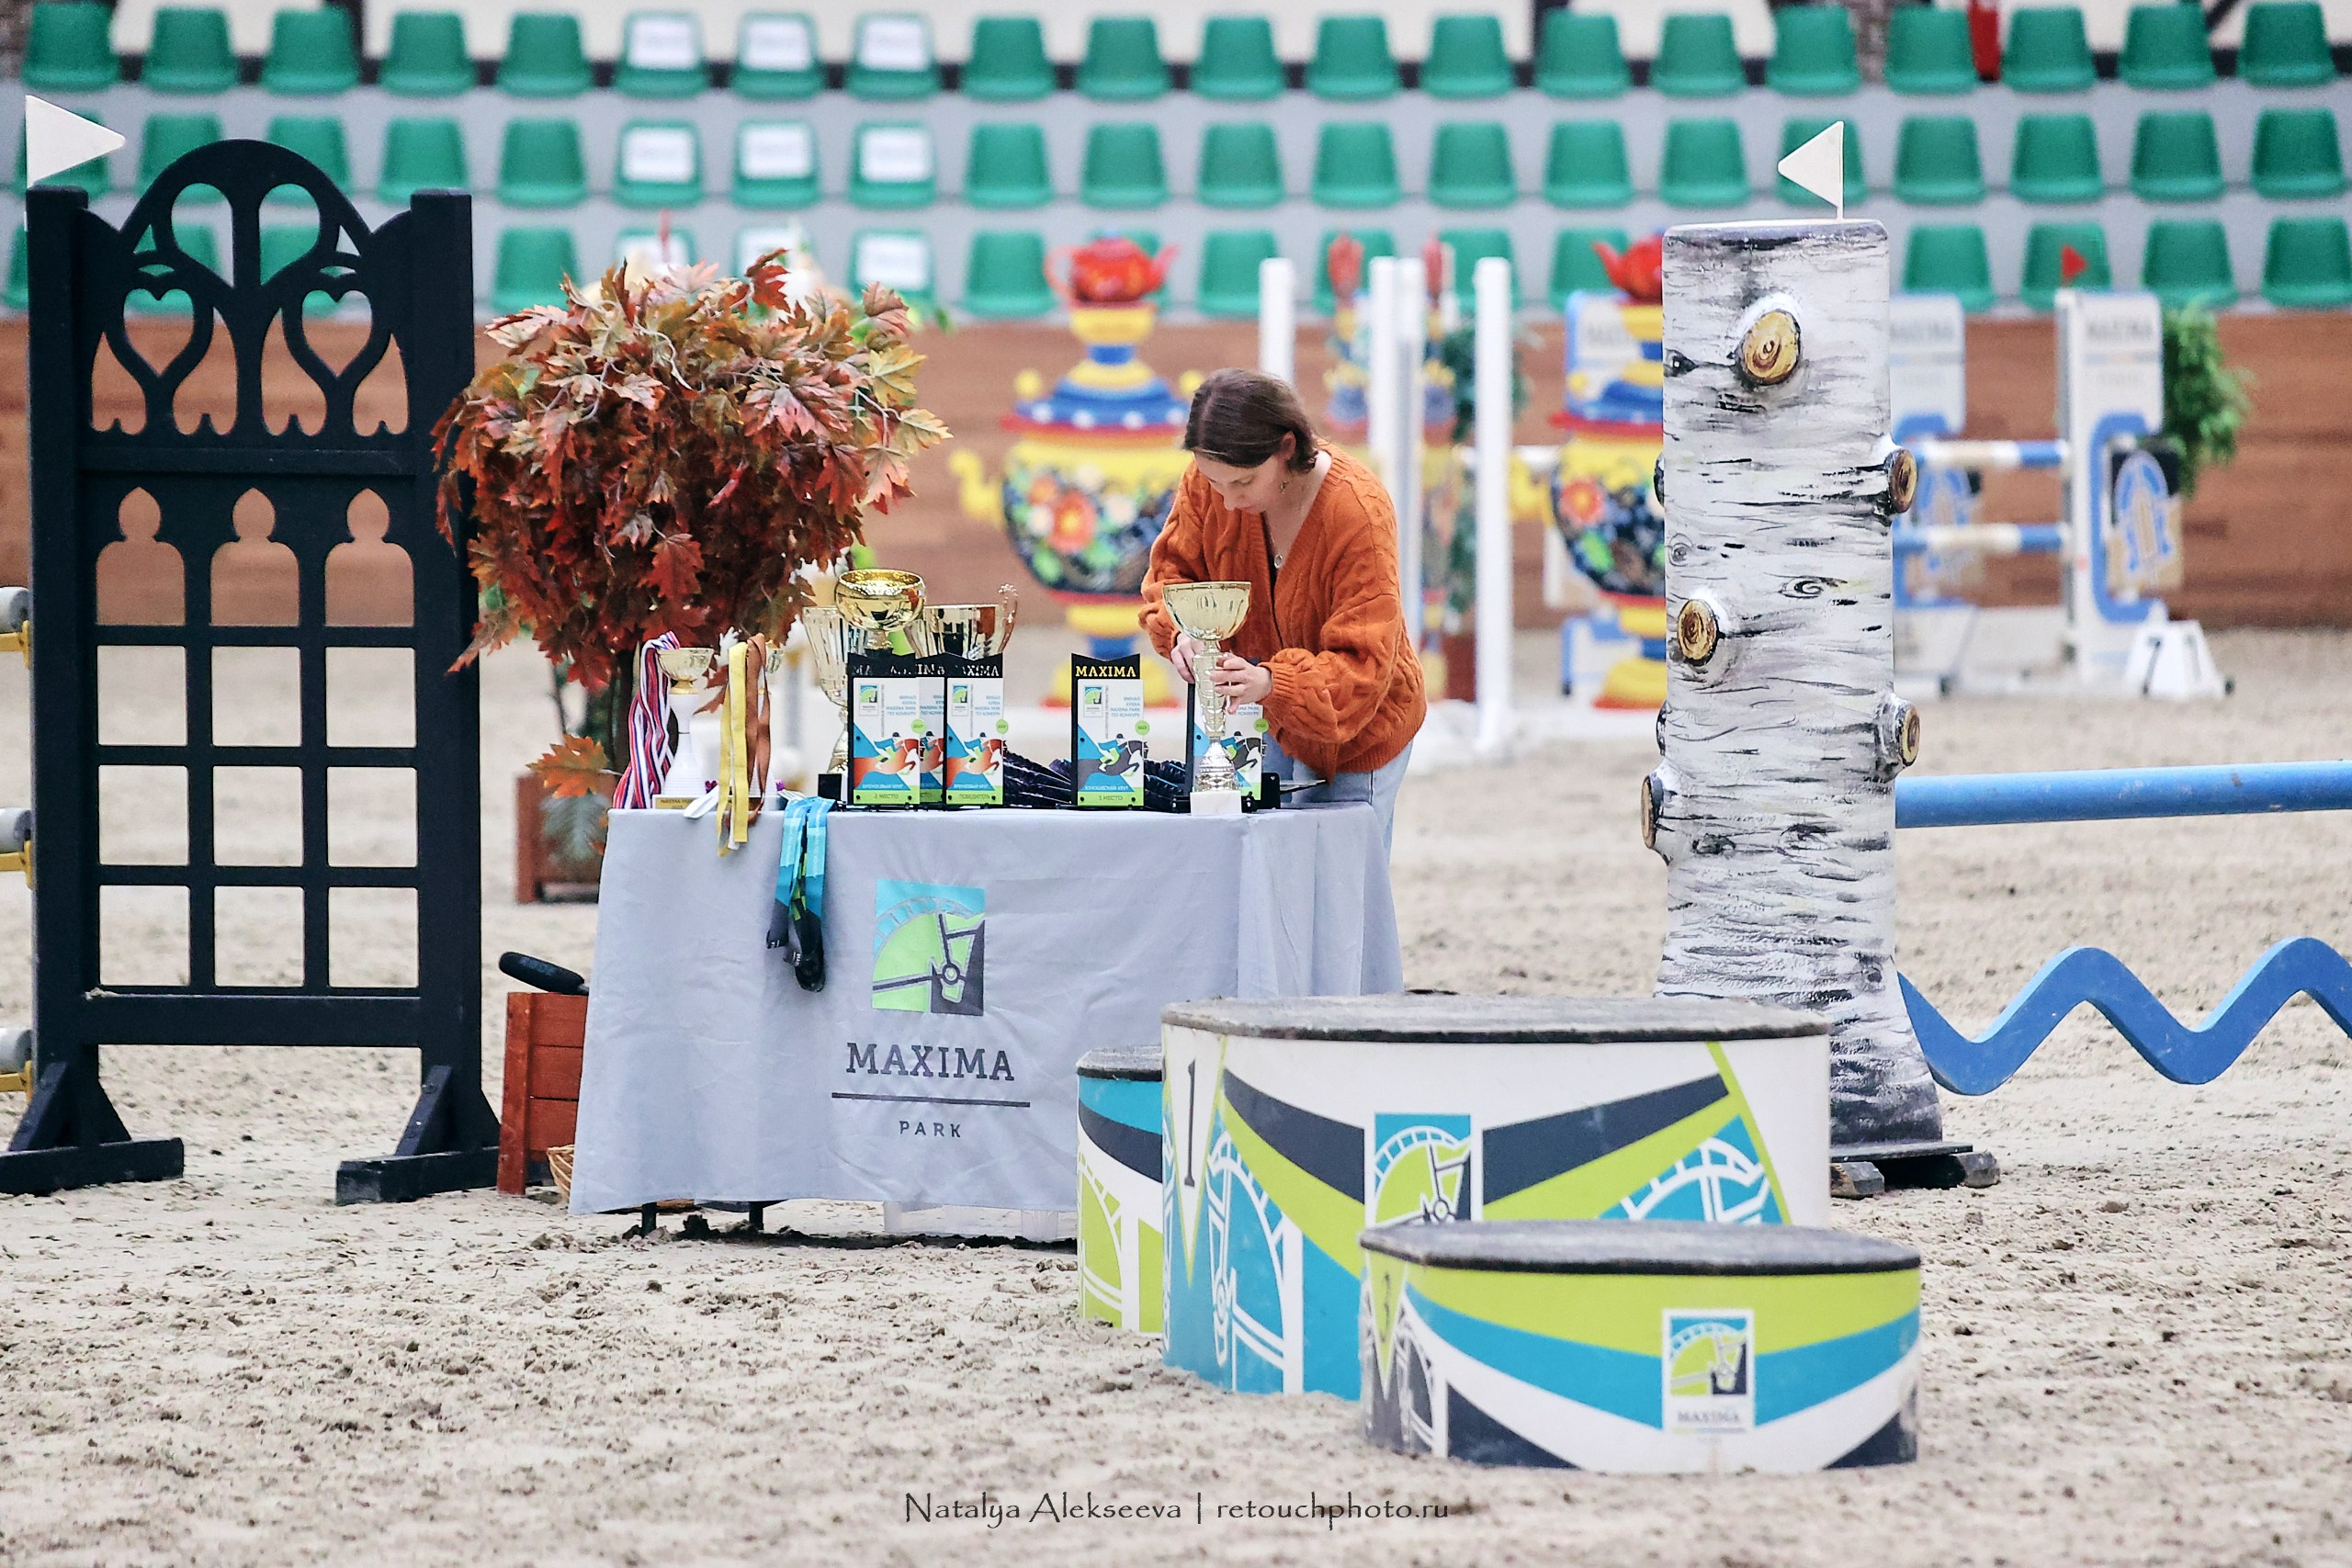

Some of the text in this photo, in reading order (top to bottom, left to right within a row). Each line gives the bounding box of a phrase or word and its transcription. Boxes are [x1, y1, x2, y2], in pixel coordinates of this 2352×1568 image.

[1075, 665, 1136, 678] MAXIMA
[846, 1042, 1015, 1081] MAXIMA
[899, 1121, 961, 1138] PARK
